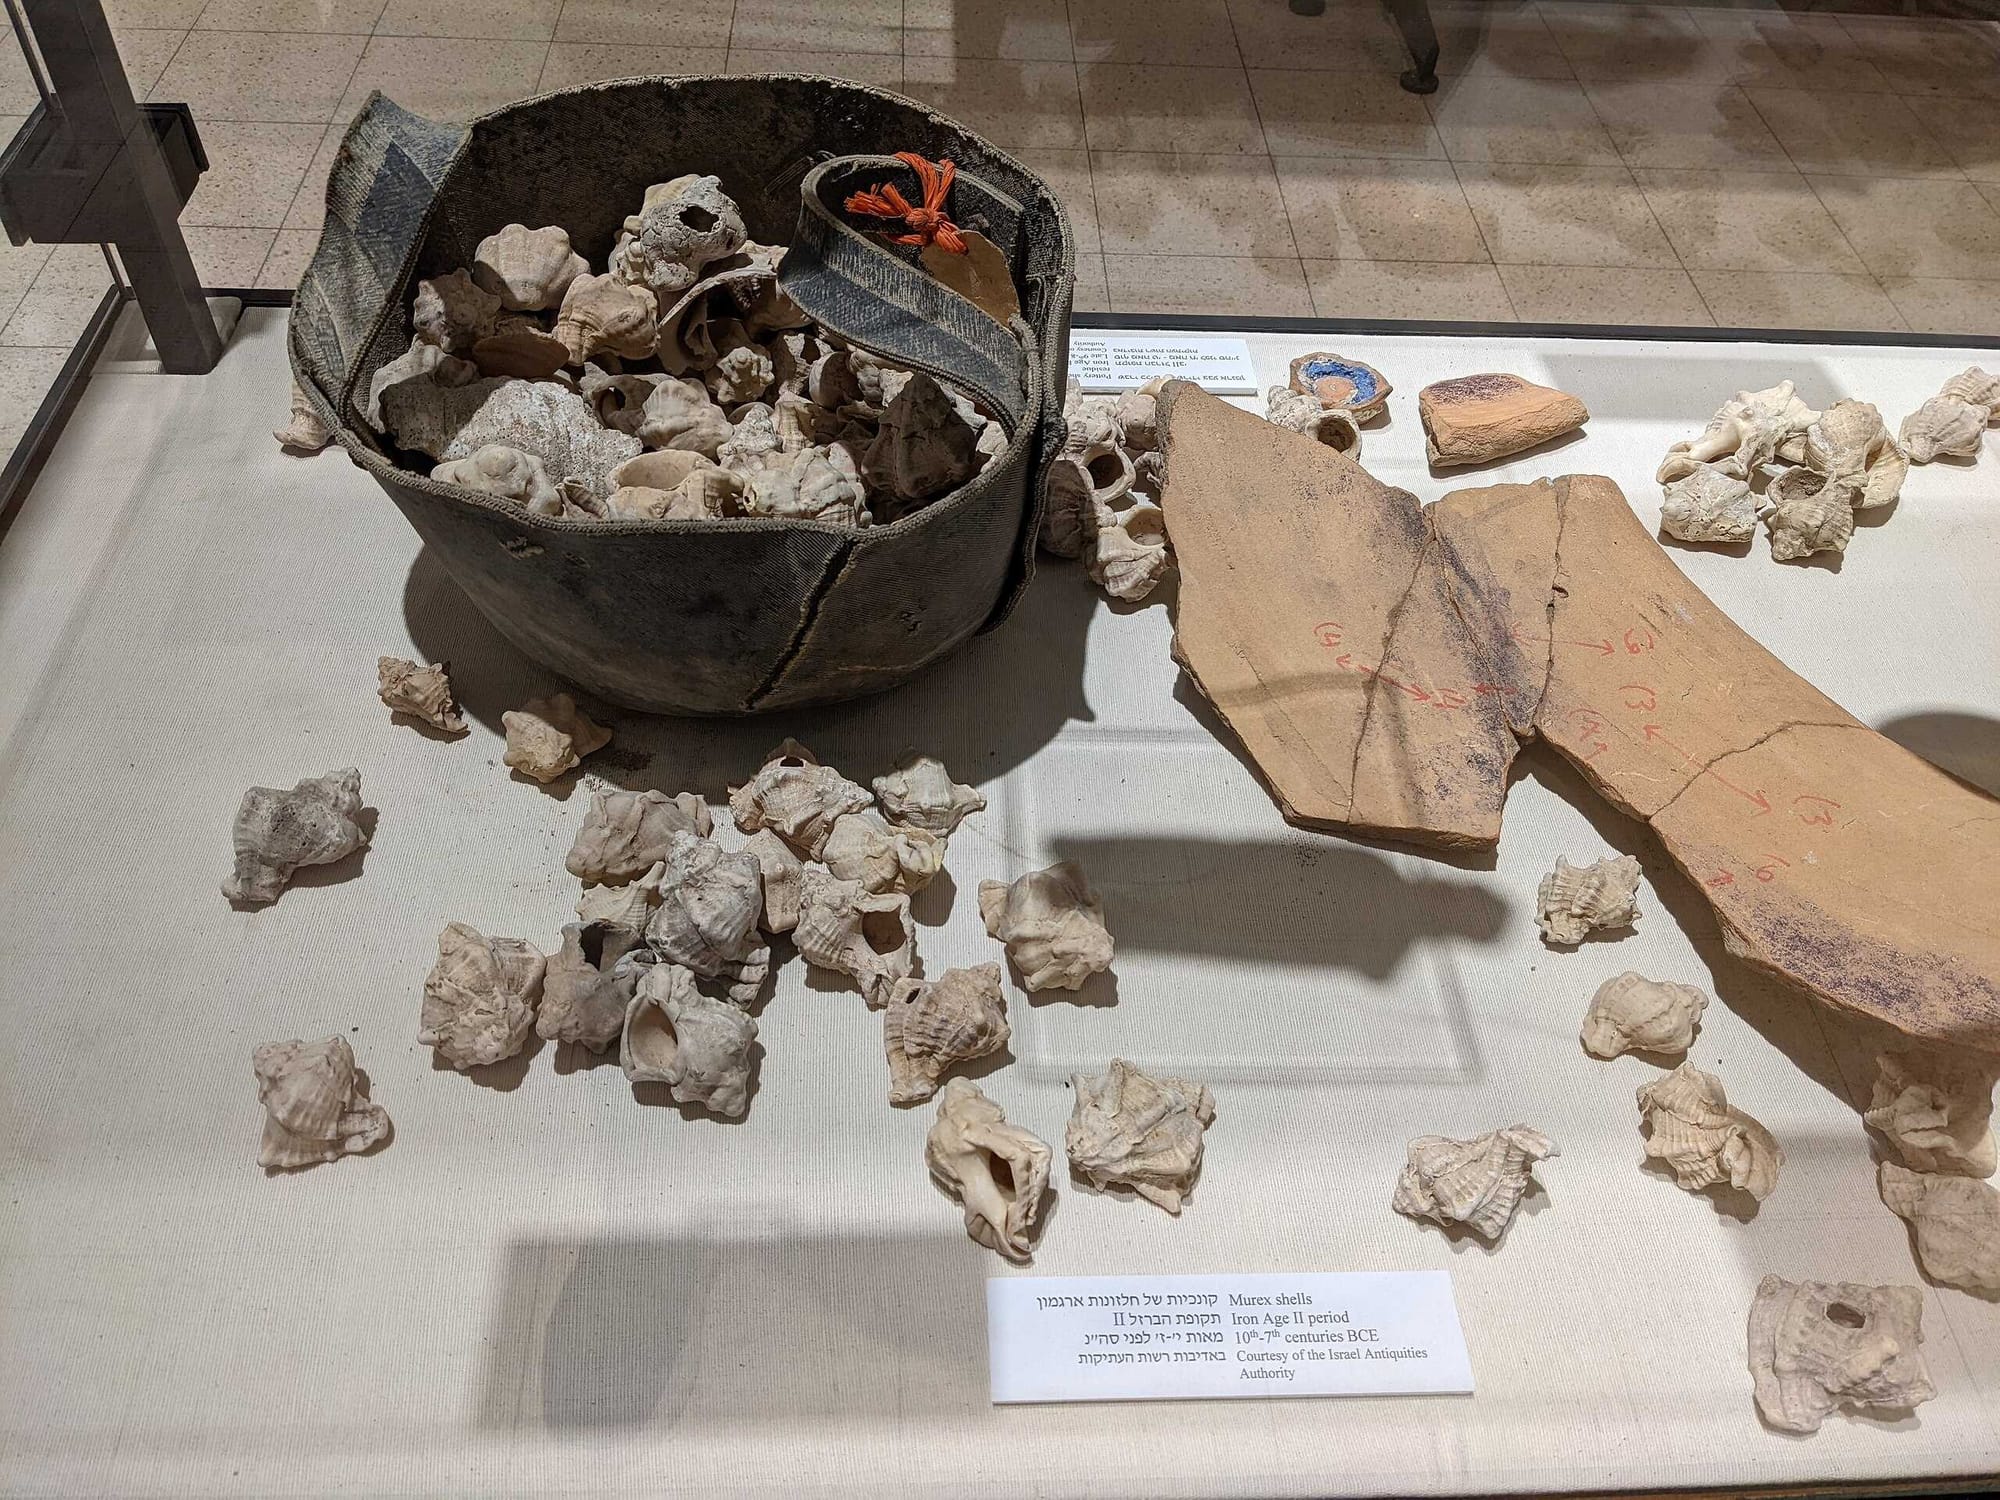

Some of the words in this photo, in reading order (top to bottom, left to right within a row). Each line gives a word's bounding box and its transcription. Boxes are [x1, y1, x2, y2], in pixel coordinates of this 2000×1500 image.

[1036, 1296, 1084, 1310] ארגמון
[1088, 1293, 1140, 1307] חלזונות
[1143, 1292, 1162, 1306] של
[1167, 1293, 1218, 1307] קונכיות
[1229, 1293, 1272, 1306] Murex
[1276, 1292, 1313, 1305] shells
[1113, 1312, 1125, 1326] II
[1129, 1312, 1172, 1326] הברזל
[1176, 1313, 1221, 1327] תקופת
[1232, 1312, 1258, 1325] Iron
[1263, 1312, 1290, 1327] Age
[1293, 1311, 1304, 1324] II
[1308, 1310, 1350, 1327] period
[1124, 1331, 1151, 1345] לפני
[1186, 1332, 1224, 1343] מאות
[1235, 1329, 1280, 1344] 10th-7th
[1285, 1330, 1344, 1343] centuries
[1347, 1329, 1379, 1342] BCE
[1078, 1352, 1134, 1366] העתיקות
[1138, 1351, 1170, 1363] רשות
[1173, 1351, 1226, 1362] באדיבות
[1236, 1350, 1289, 1364] Courtesy
[1292, 1348, 1306, 1361] of
[1308, 1349, 1325, 1360] the
[1329, 1348, 1361, 1360] Israel
[1364, 1347, 1428, 1362] Antiquities
[1239, 1366, 1295, 1381] Authority
